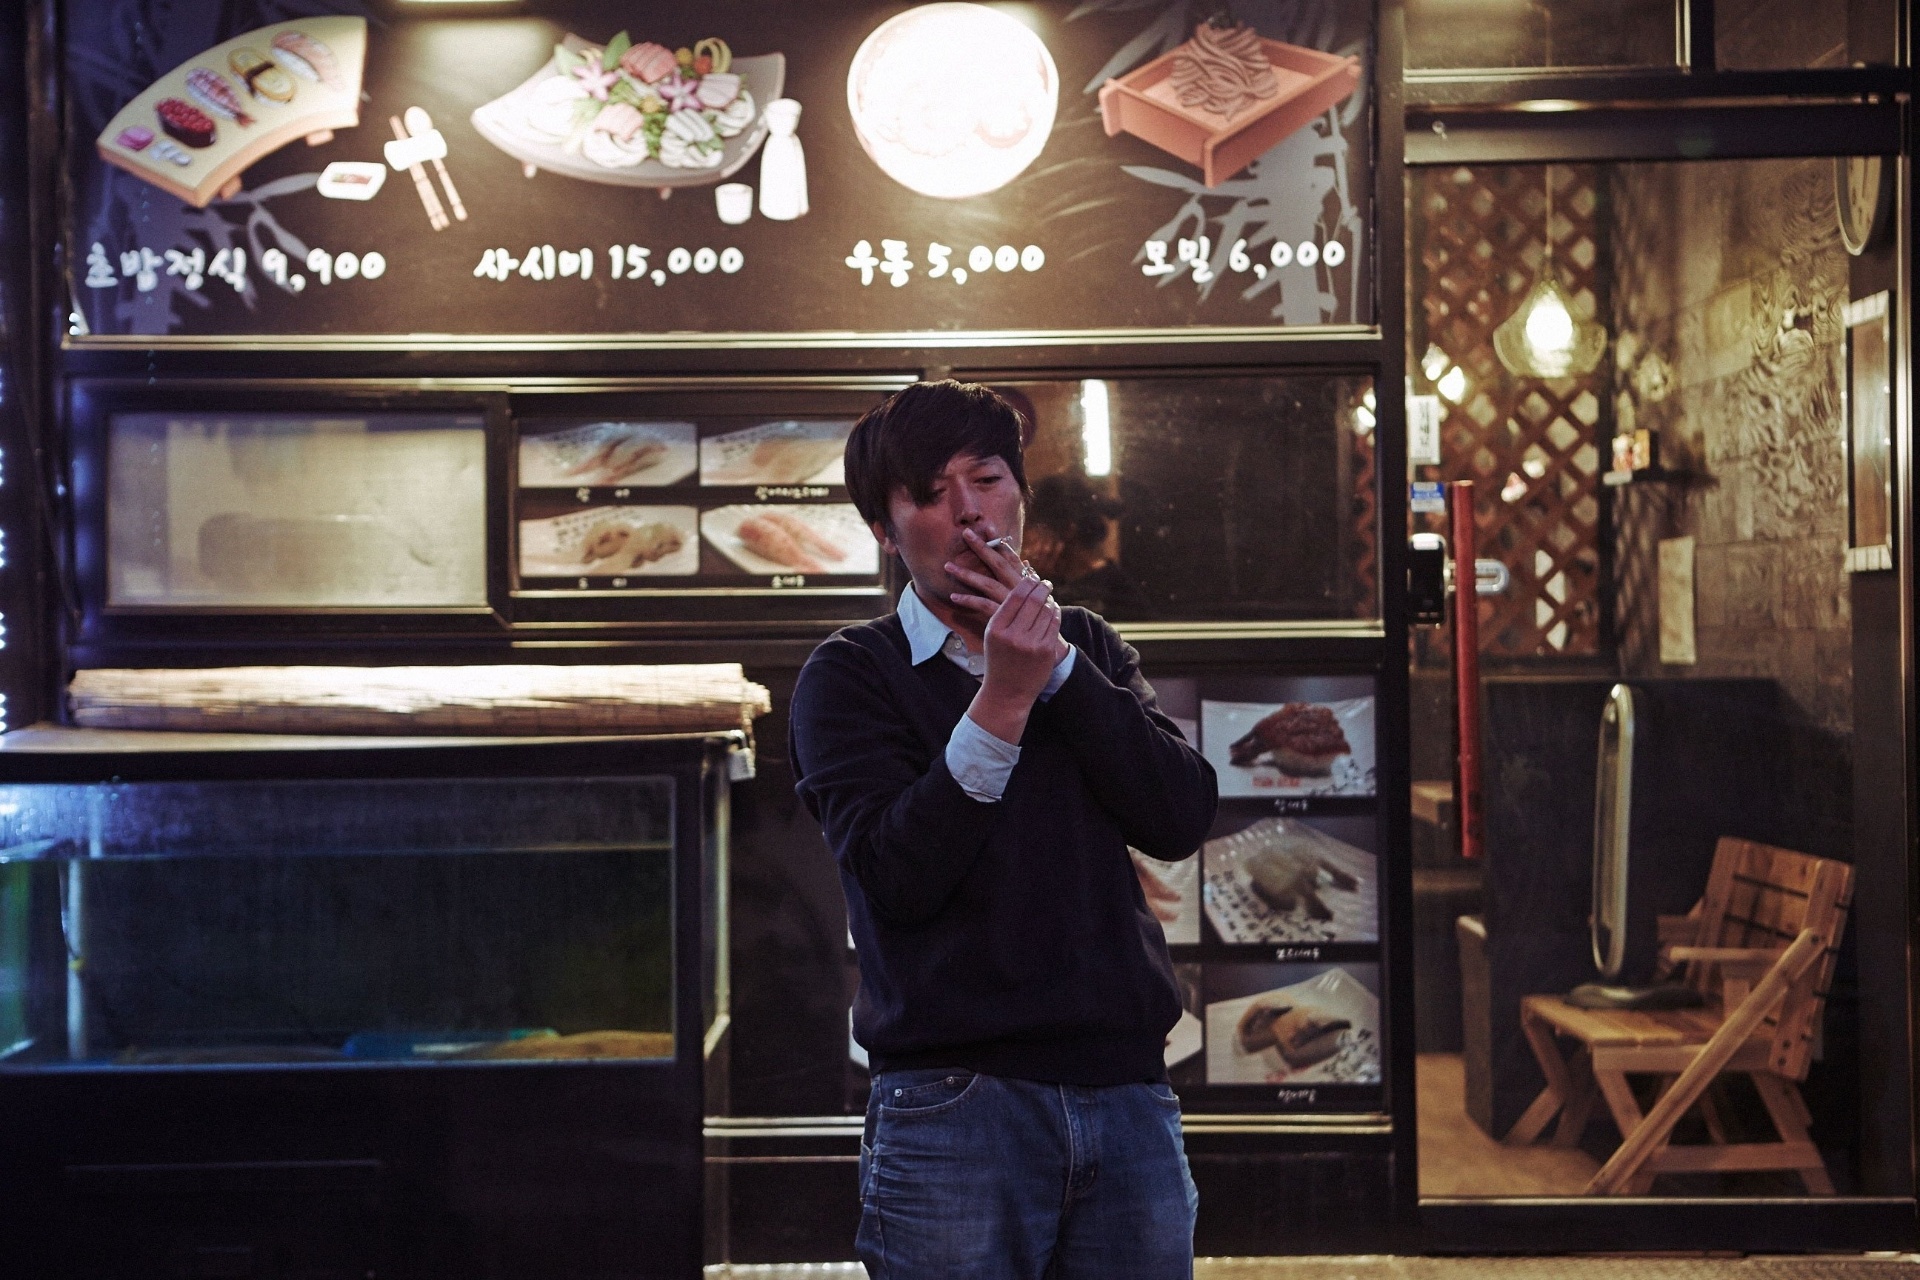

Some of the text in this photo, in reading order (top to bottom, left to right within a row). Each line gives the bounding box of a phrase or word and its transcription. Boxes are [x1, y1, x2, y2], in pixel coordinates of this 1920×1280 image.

[84, 241, 387, 293] 초밥정식 9,900
[472, 243, 745, 287] 사시미 15,000
[844, 238, 1046, 289] 우동 5,000
[1141, 235, 1346, 284] 모밀 6,000
